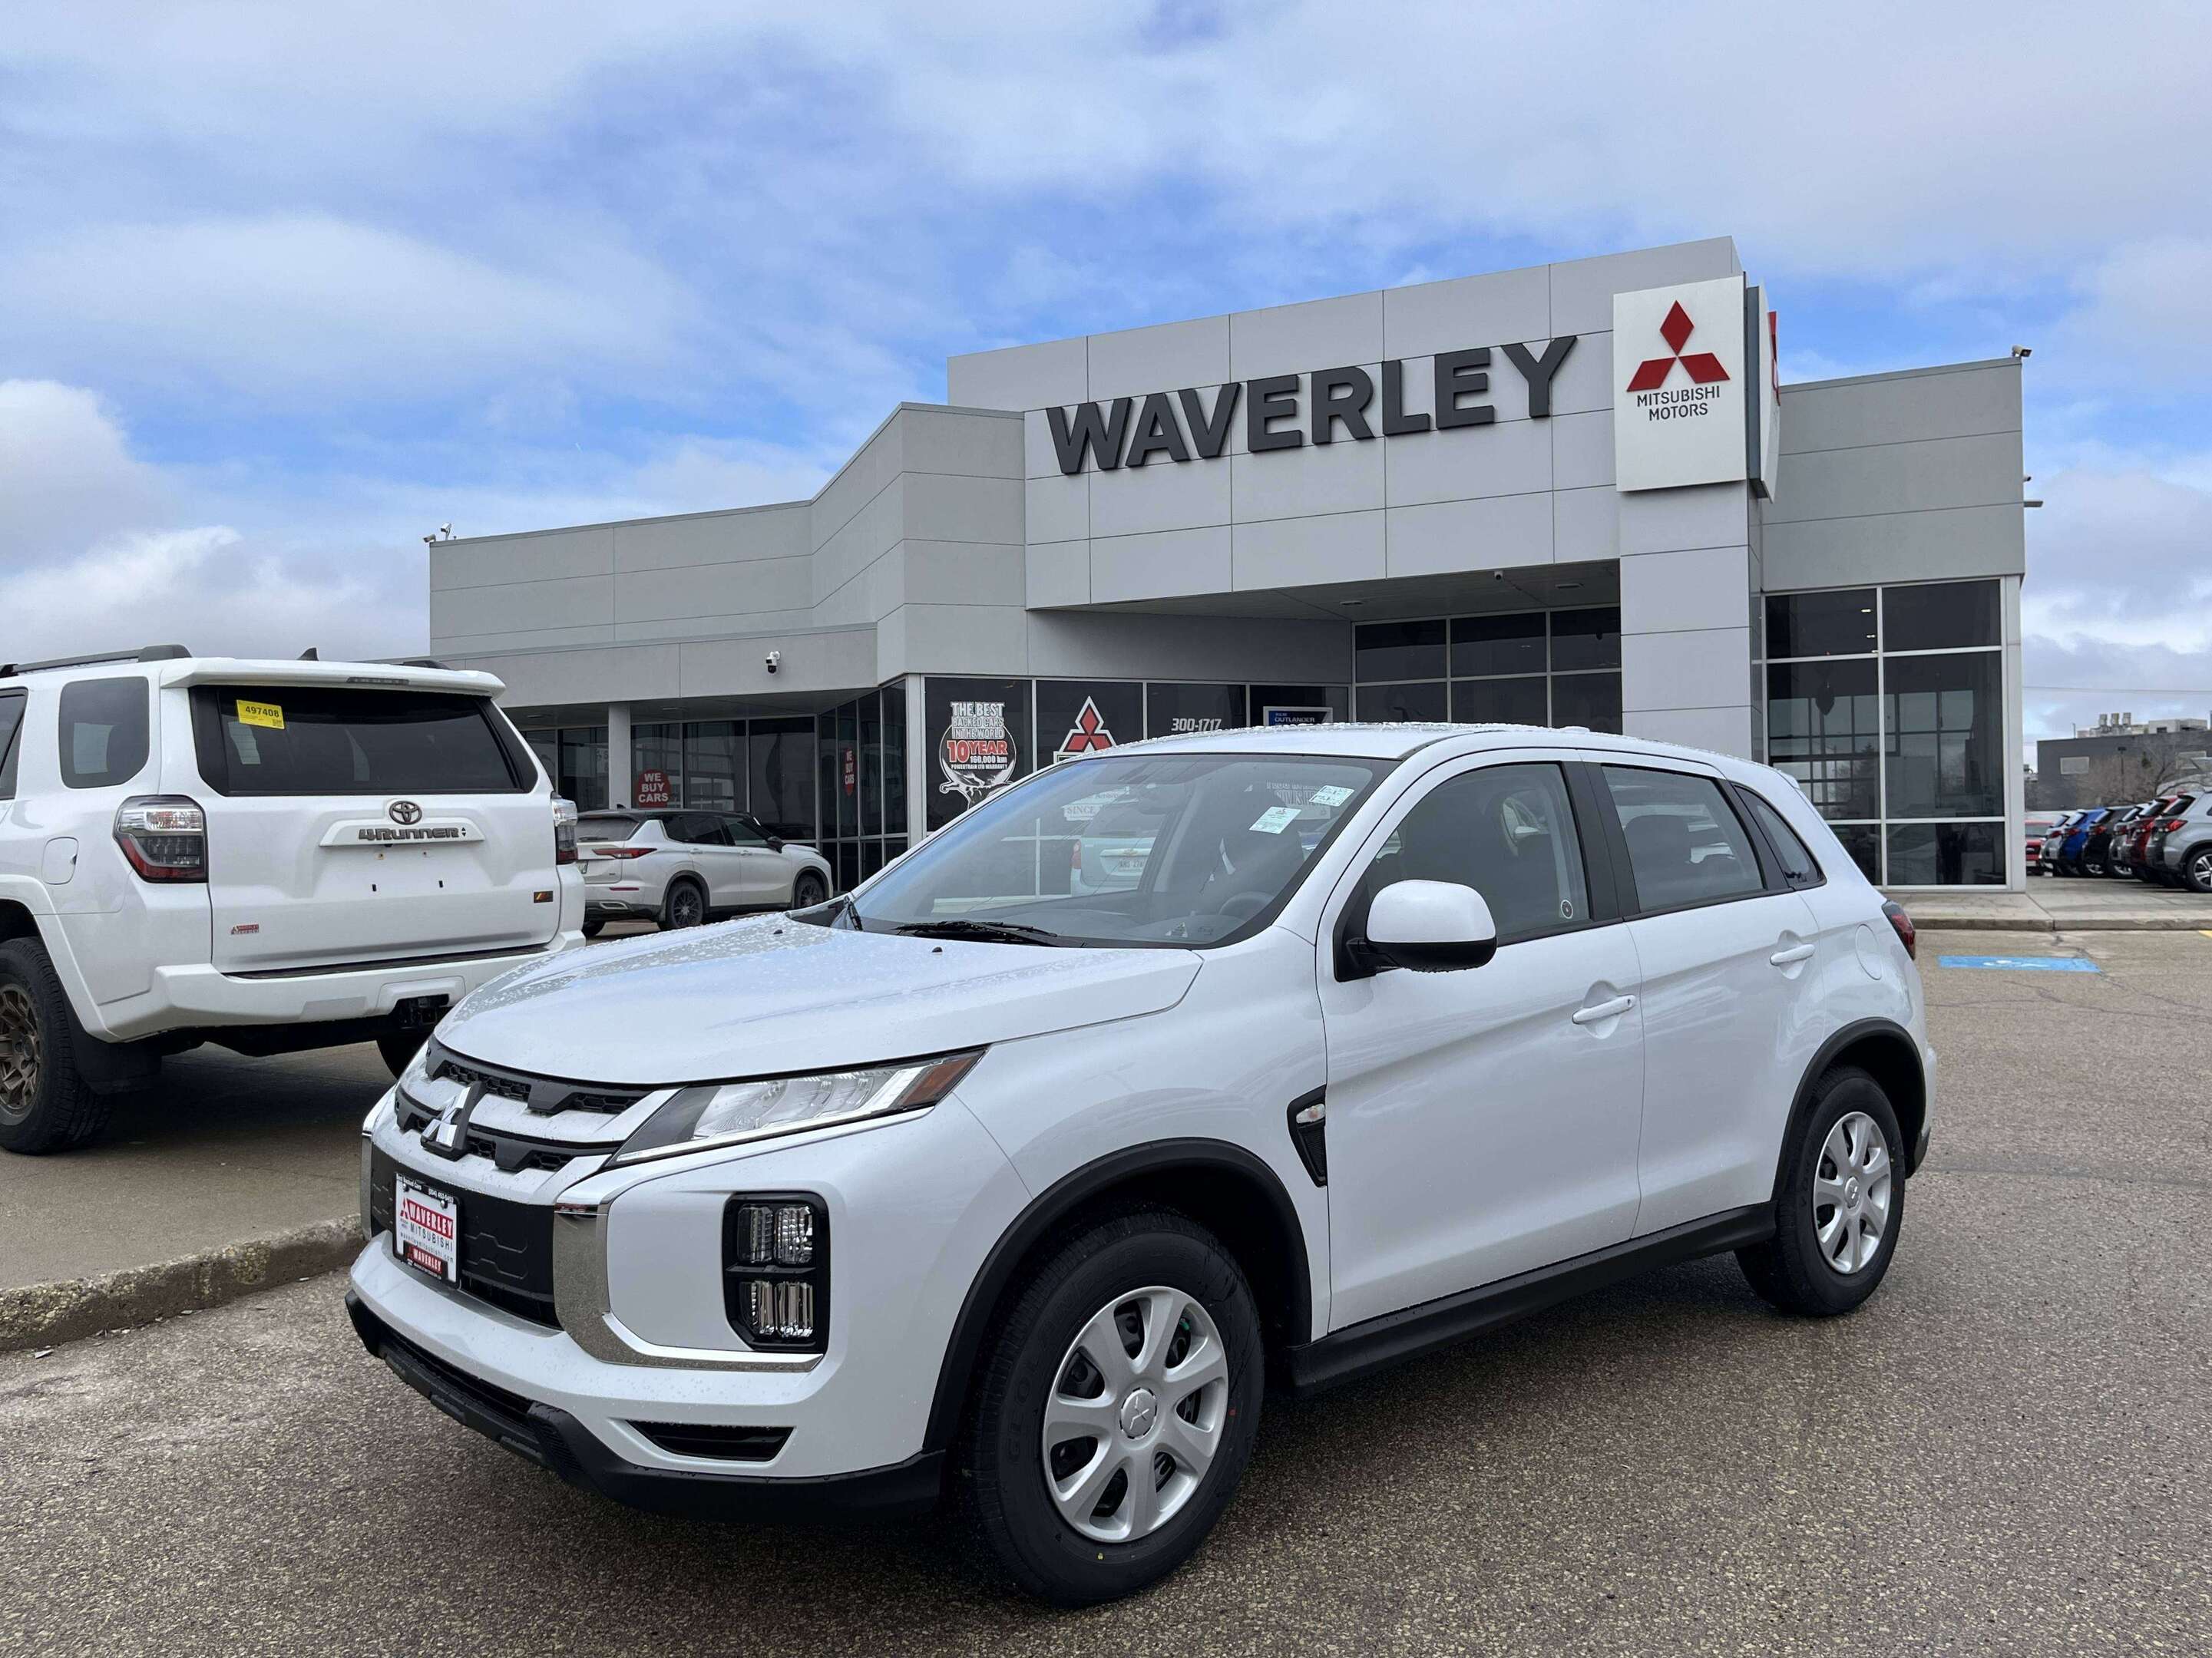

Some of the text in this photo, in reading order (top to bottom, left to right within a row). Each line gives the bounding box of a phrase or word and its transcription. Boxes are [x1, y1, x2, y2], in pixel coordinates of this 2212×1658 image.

[1637, 385, 1720, 407] MITSUBISHI
[1046, 335, 1577, 474] WAVERLEY
[1649, 402, 1708, 421] MOTORS
[246, 706, 279, 718] 497408
[951, 702, 1005, 717] THE BEST
[952, 717, 1004, 728] BACKED CARS
[1171, 718, 1222, 732] 300-1717
[953, 728, 1005, 738] IN THE WORLD
[947, 740, 1008, 763] 10 YEAR
[970, 755, 996, 764] 160,000
[644, 772, 661, 782] WE
[641, 783, 665, 792] BUY
[638, 793, 669, 803] CARS
[409, 1201, 453, 1237] WAVERLEY
[411, 1222, 453, 1251] MITSUBISHI
[413, 1247, 441, 1272] WAVERLEY
